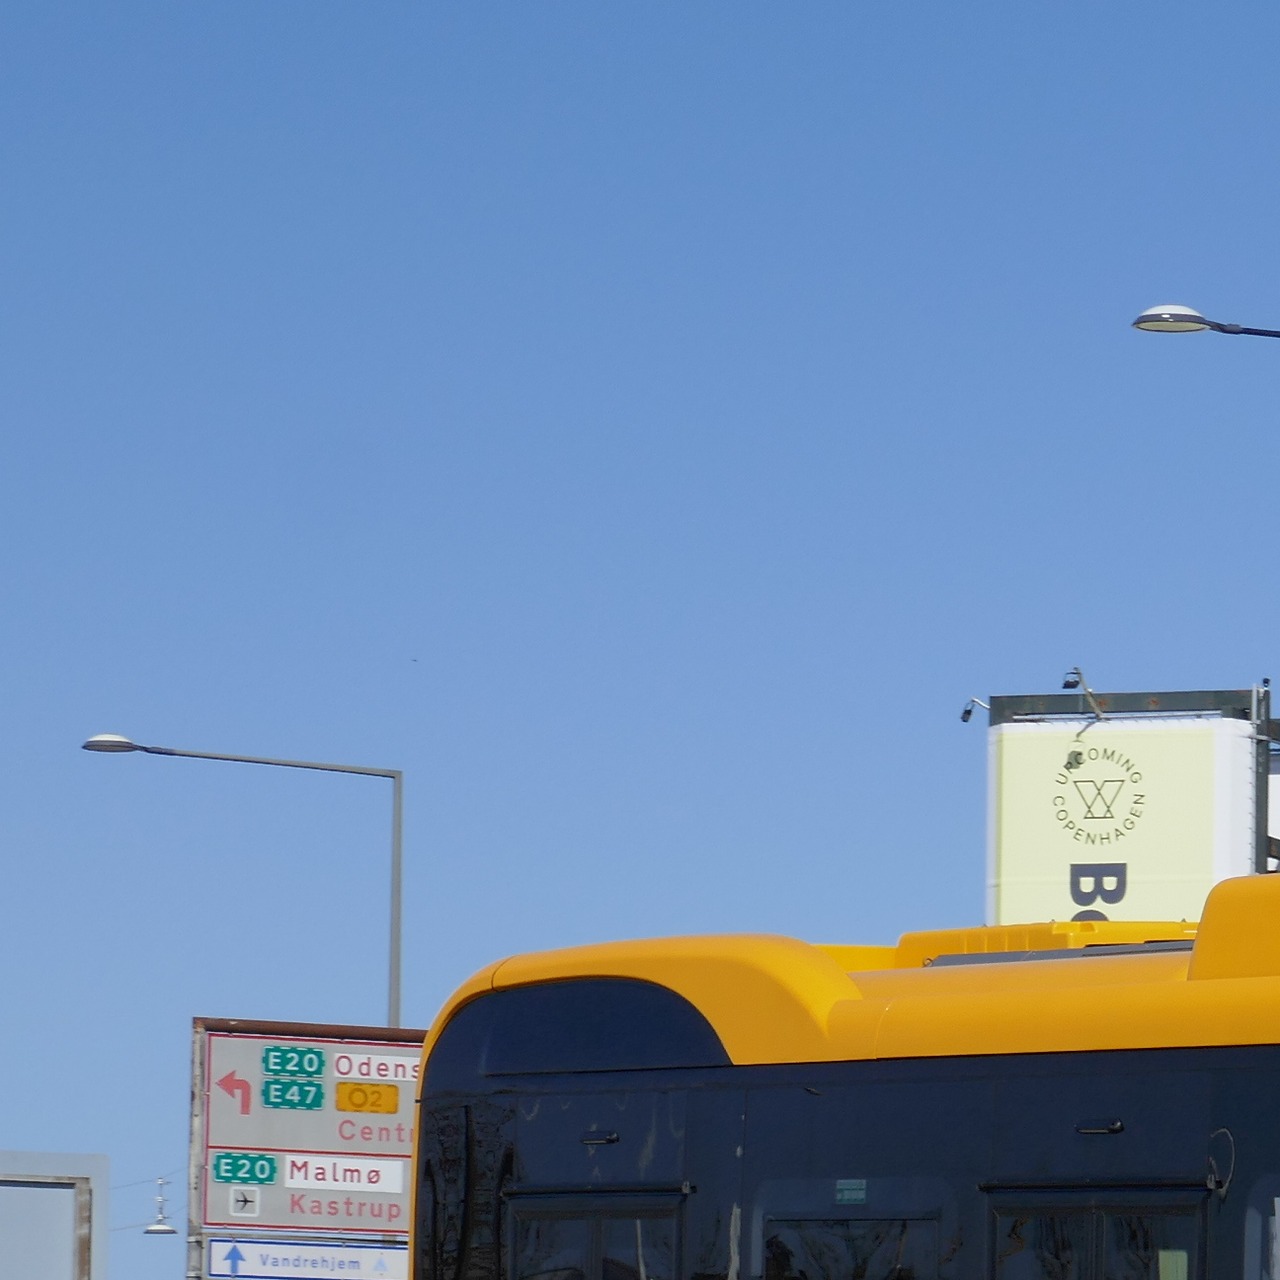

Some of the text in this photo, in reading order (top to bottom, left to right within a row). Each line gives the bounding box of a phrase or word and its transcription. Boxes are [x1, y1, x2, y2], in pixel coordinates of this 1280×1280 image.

[1055, 748, 1142, 785] UPCOMING
[1053, 794, 1145, 845] COPENHAGEN
[1070, 863, 1127, 921] B
[268, 1052, 319, 1071] E20
[269, 1084, 318, 1104] E47
[219, 1159, 382, 1184] E20 Malmø
[290, 1194, 402, 1222] Kastrup
[260, 1254, 361, 1272] Vandrehjem
